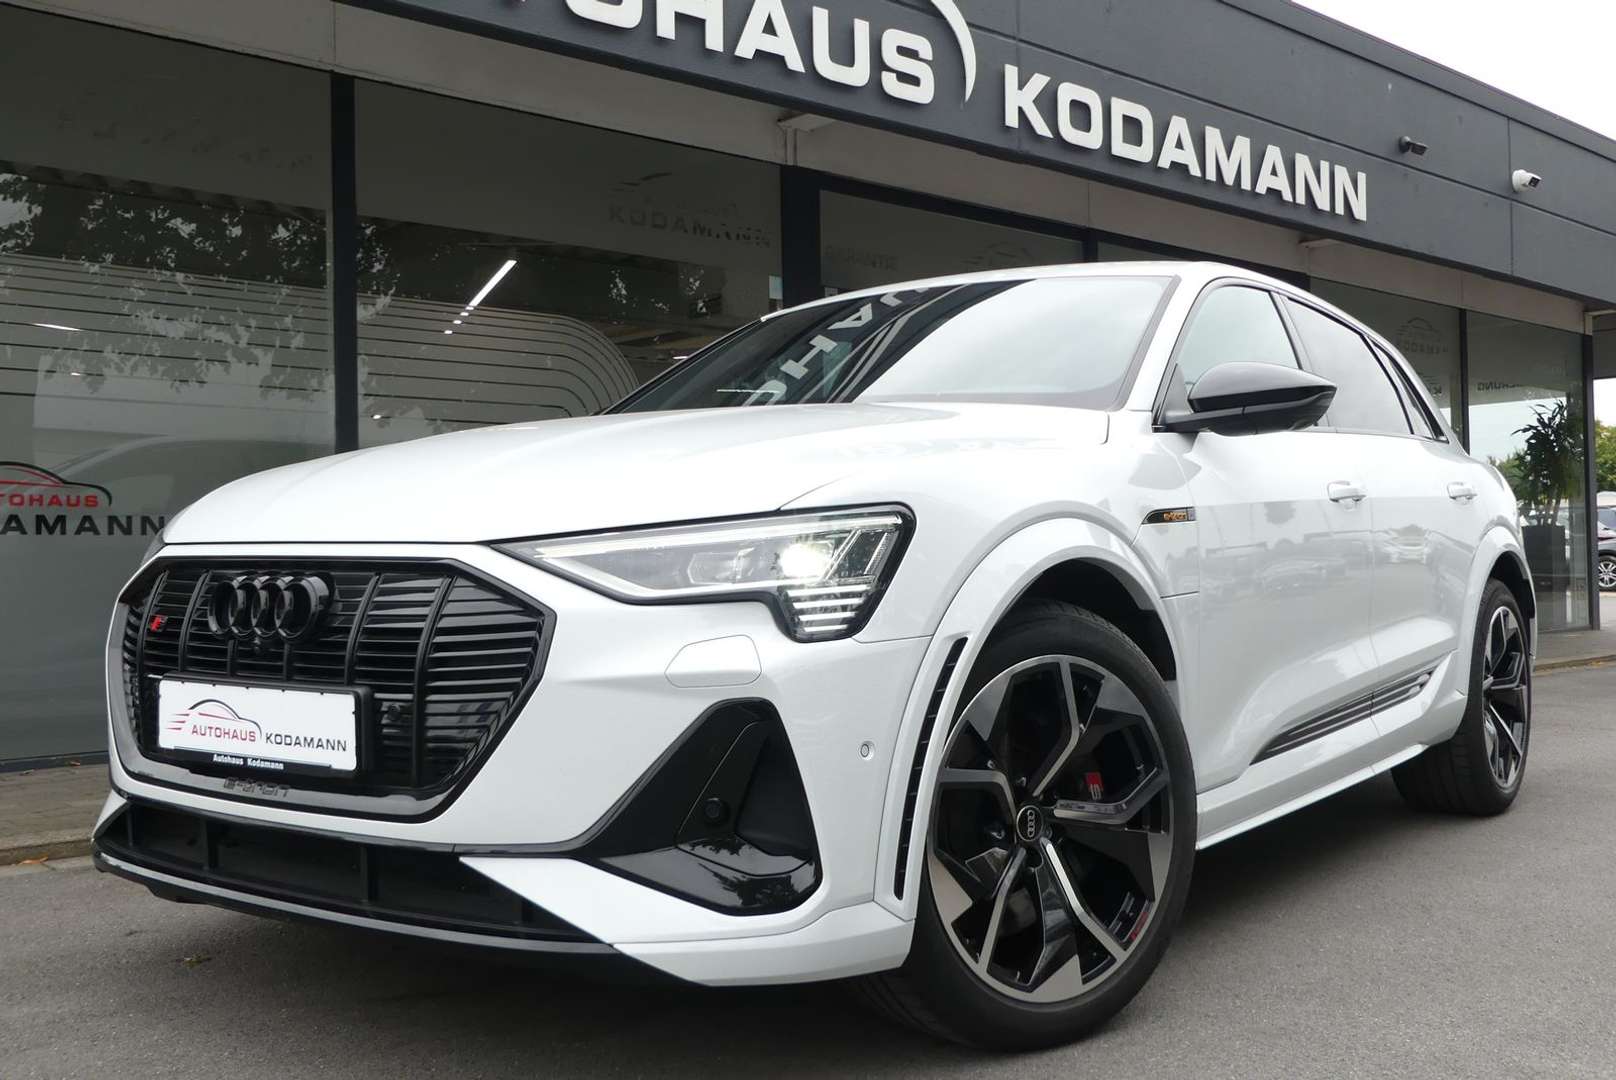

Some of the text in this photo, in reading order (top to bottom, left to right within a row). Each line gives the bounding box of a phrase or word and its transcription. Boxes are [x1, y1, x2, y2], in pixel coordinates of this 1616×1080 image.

[1004, 63, 1368, 222] KODAMANN
[191, 724, 347, 752] AUTOHAUS KODAMANN
[212, 753, 285, 770] Autohaus Kodamann
